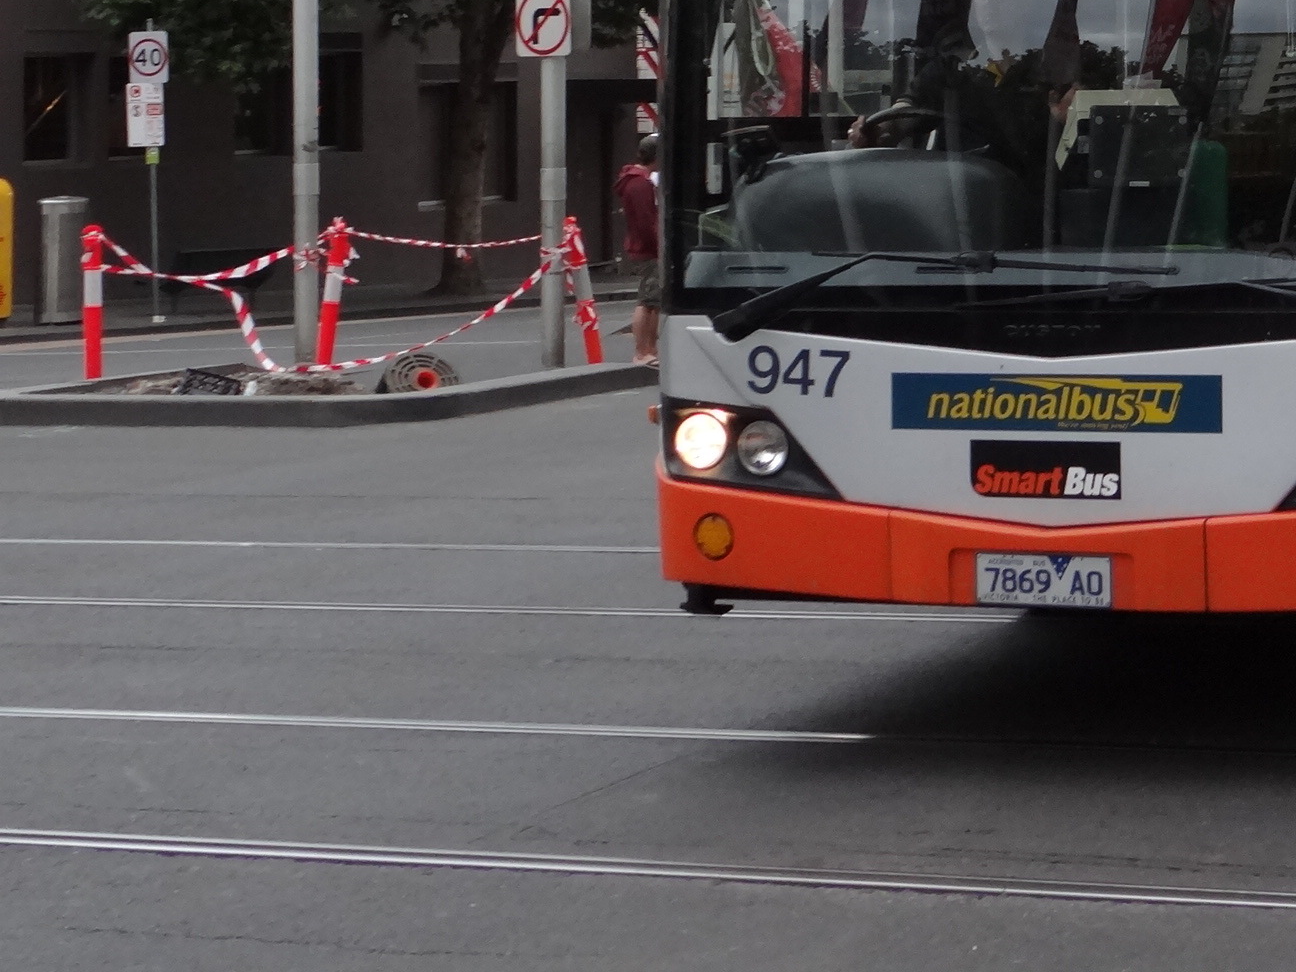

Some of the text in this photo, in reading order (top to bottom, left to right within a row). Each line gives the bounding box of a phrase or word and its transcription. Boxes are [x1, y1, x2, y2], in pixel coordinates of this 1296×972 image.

[135, 48, 161, 67] 40
[747, 345, 851, 398] 947
[926, 385, 1138, 421] nationalbus
[984, 567, 1052, 594] 7869
